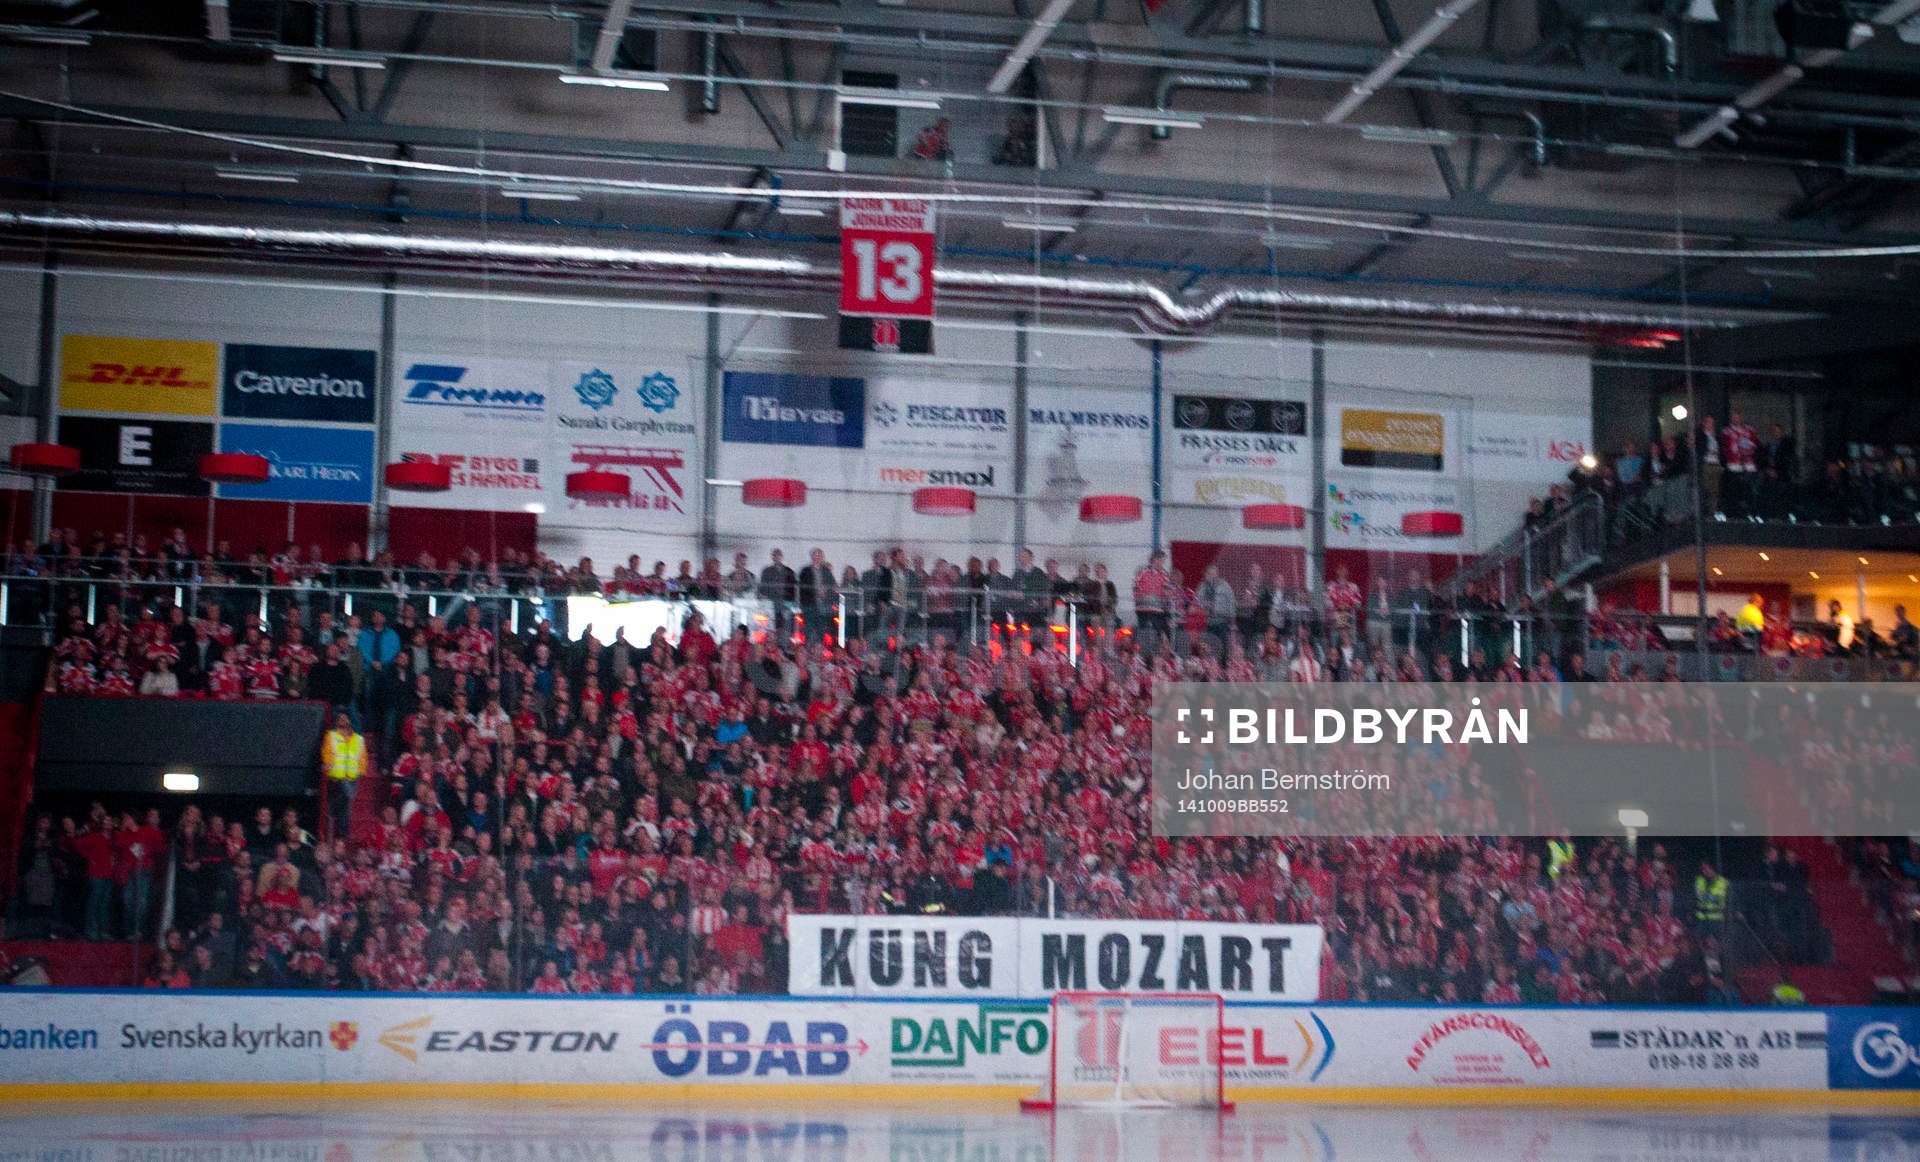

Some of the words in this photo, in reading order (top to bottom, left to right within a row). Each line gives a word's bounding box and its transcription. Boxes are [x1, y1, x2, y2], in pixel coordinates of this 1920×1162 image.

[852, 238, 922, 303] 13
[91, 363, 185, 388] DHL
[234, 369, 366, 399] Caverion
[558, 415, 608, 430] Suzuki
[907, 405, 1007, 424] PISCATOR
[1030, 409, 1150, 430] MALMBERGS
[1181, 434, 1250, 451] FRASSES
[470, 473, 543, 490] HANDEL
[820, 927, 992, 989] KÜNG
[1042, 931, 1291, 994] MOZART
[121, 1023, 226, 1049] Svenska
[233, 1023, 323, 1054] kyrkan
[425, 1030, 620, 1053] EASTON
[651, 1003, 850, 1078] ÖBAB
[889, 1014, 1049, 1057] DANFO
[1158, 1027, 1289, 1066] EEL
[1758, 1029, 1792, 1049] AB
[1648, 1052, 1707, 1070] 019-18
[1712, 1052, 1734, 1070] 28
[1737, 1053, 1760, 1070] 88
